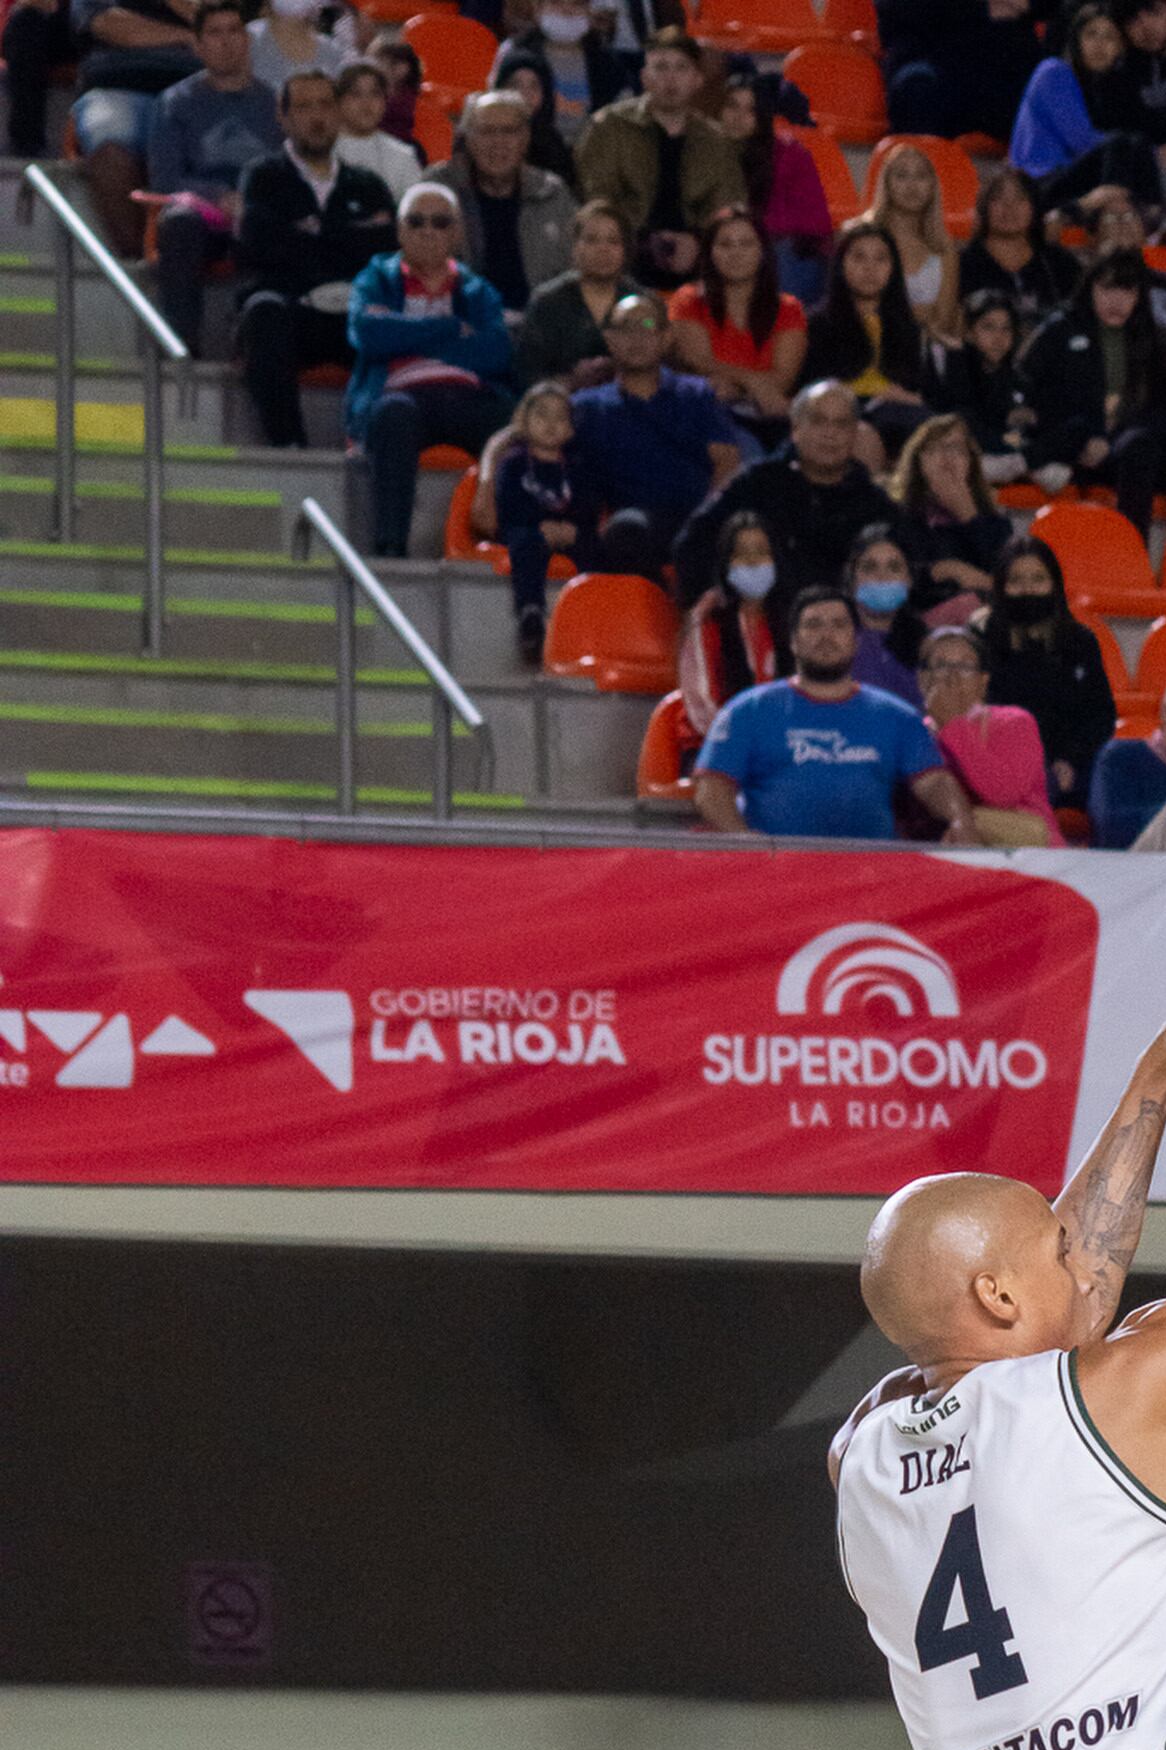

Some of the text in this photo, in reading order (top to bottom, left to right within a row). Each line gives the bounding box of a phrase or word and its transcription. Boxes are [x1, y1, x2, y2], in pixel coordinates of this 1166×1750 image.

[369, 986, 616, 1021] GOBIERNO DE
[370, 1019, 627, 1065] LA RIOJA
[703, 1034, 1047, 1089] SUPERDOMO
[789, 1102, 950, 1129] LA RIOJA
[914, 1503, 1029, 1700] 4
